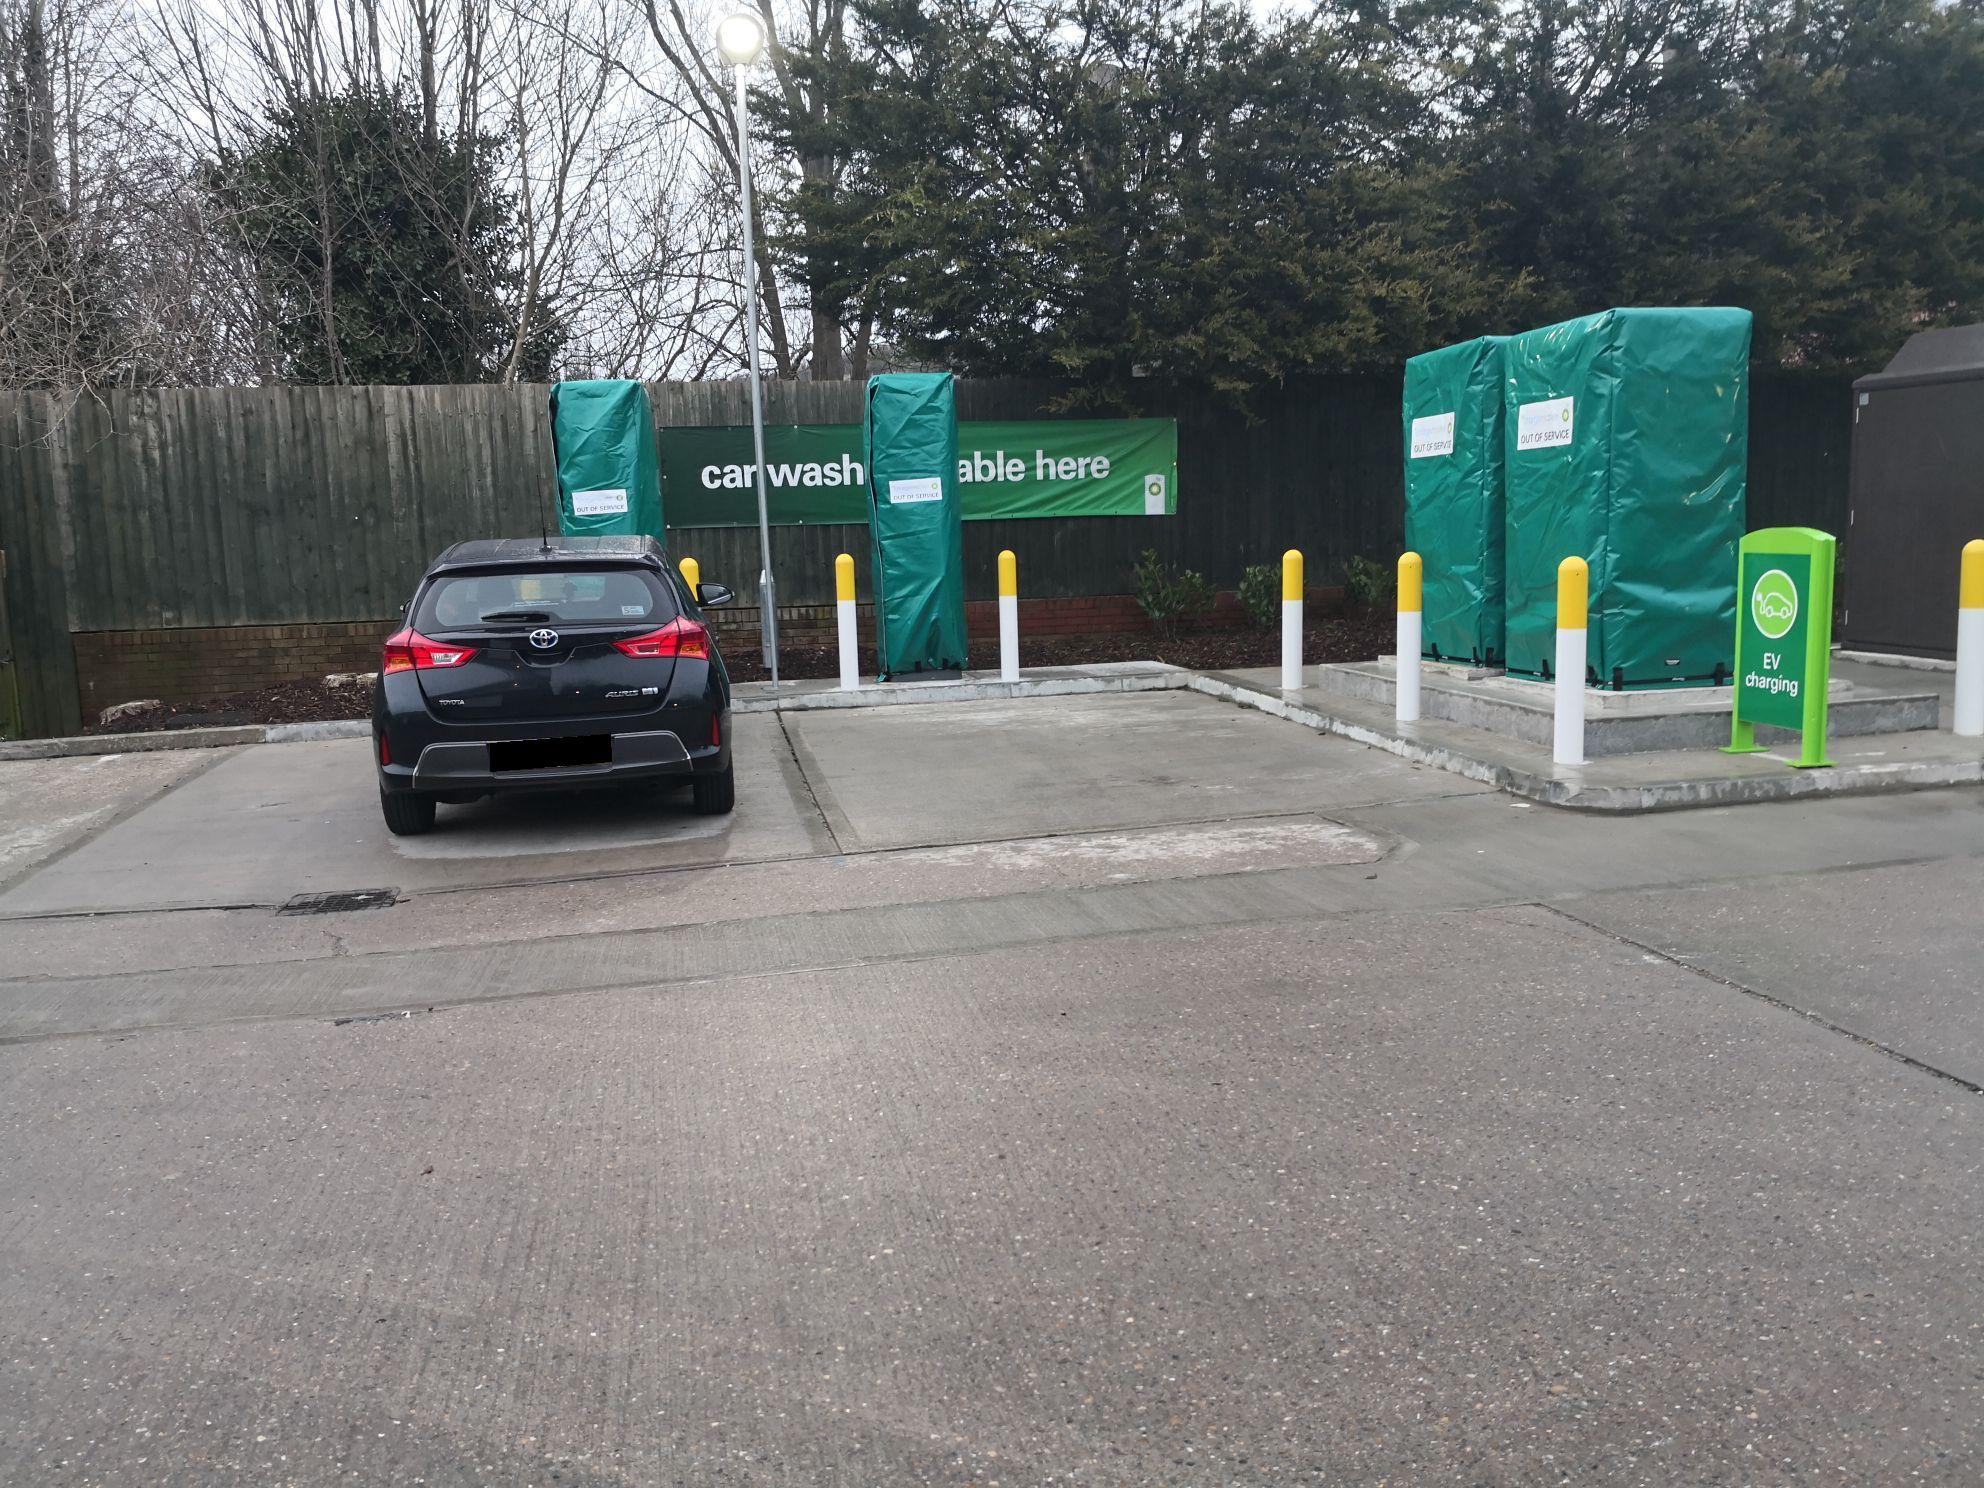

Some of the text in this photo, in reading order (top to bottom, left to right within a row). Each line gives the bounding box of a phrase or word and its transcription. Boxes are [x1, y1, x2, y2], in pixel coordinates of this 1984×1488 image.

[1521, 429, 1570, 443] OUT OF SERVICE
[1414, 444, 1426, 452] OUT
[701, 464, 757, 489] car
[766, 453, 864, 487] wash
[1036, 449, 1110, 480] here
[599, 503, 624, 512] SERVICE
[1763, 652, 1781, 670] EV
[1745, 671, 1799, 697] charging
